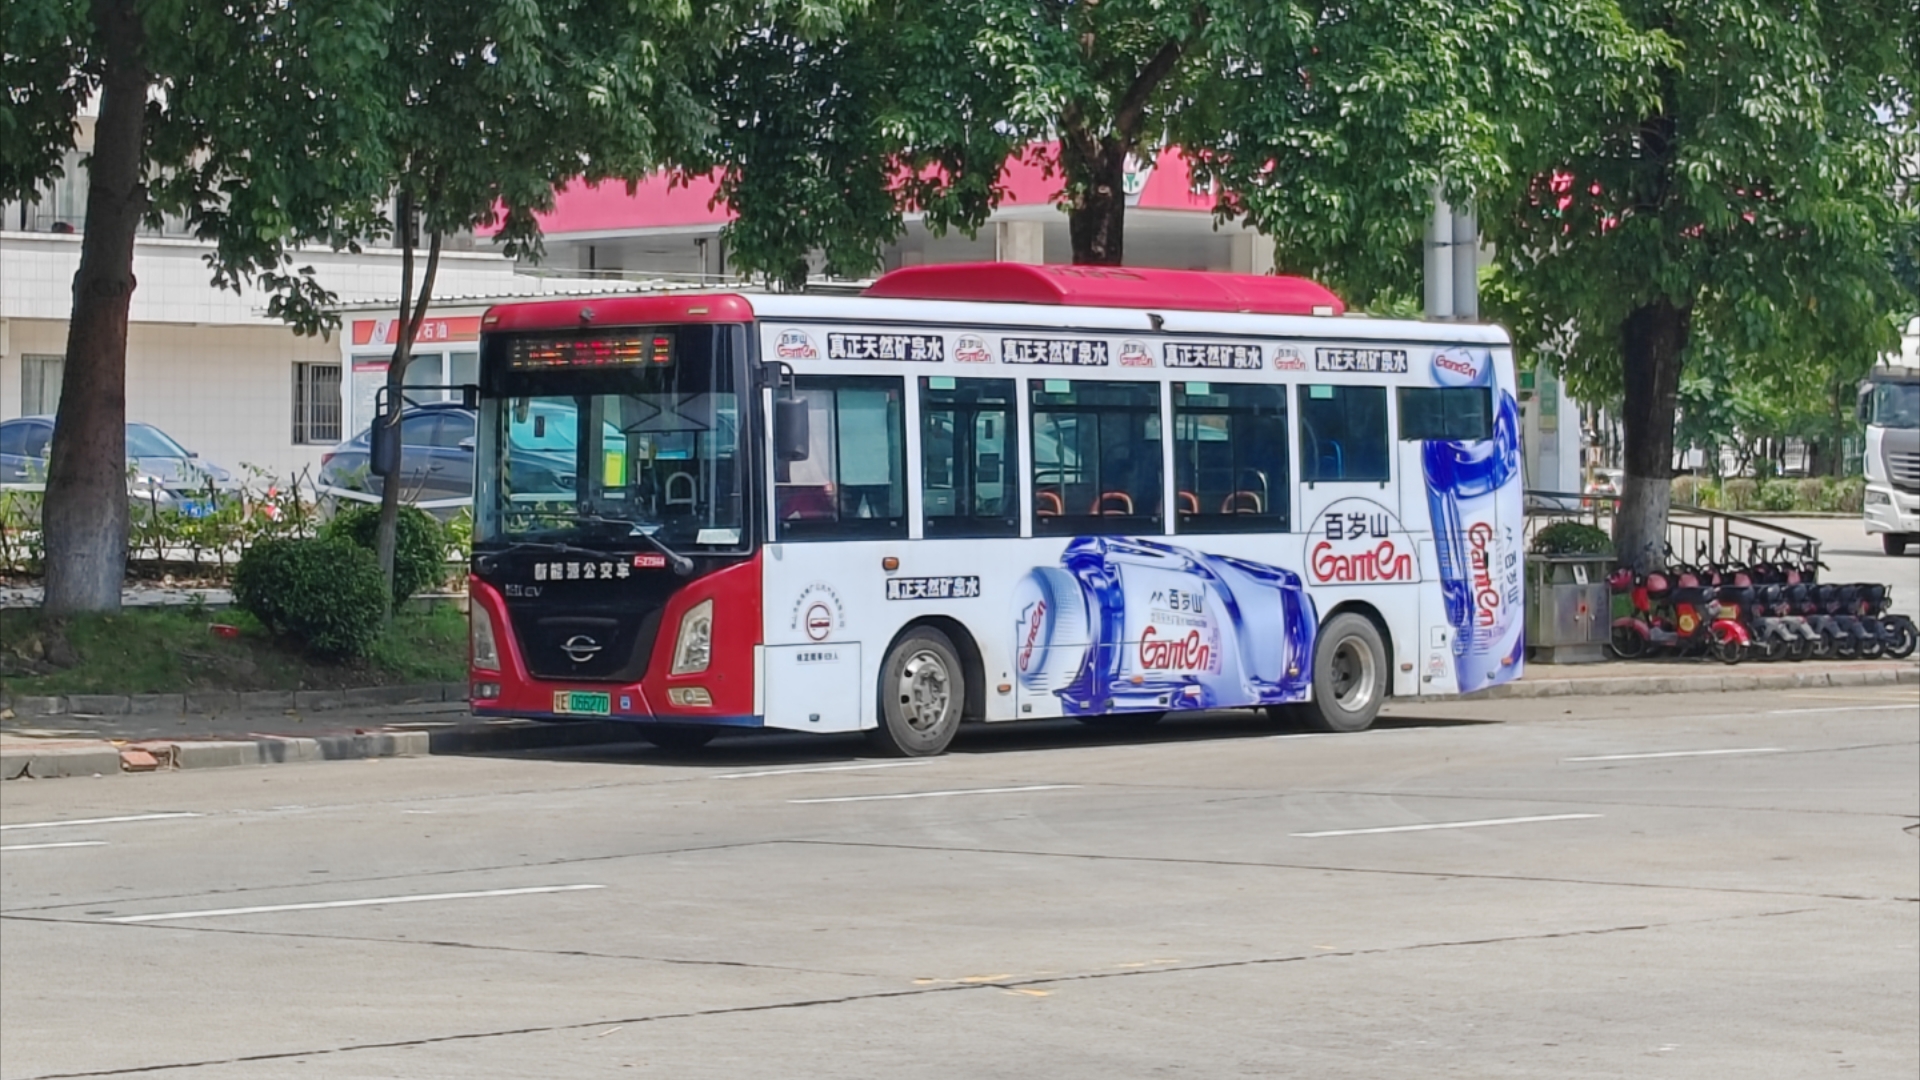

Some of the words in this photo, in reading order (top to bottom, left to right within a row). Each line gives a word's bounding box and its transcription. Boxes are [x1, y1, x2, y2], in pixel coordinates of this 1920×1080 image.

[829, 333, 944, 360] 真正天然矿泉水
[1002, 338, 1108, 365] 真正天然矿泉水
[1165, 344, 1261, 369] 真正天然矿泉水
[1316, 348, 1407, 373] 真正天然矿泉水
[1323, 512, 1390, 540] 百岁山
[534, 559, 630, 581] 新能源公交车
[1311, 540, 1412, 582] Ganten
[1468, 521, 1500, 627] Ganten
[887, 577, 979, 600] 真正天然矿泉水
[1504, 549, 1519, 605] 百岁山
[1168, 588, 1203, 613] 百岁山
[1139, 625, 1210, 670] Ganten
